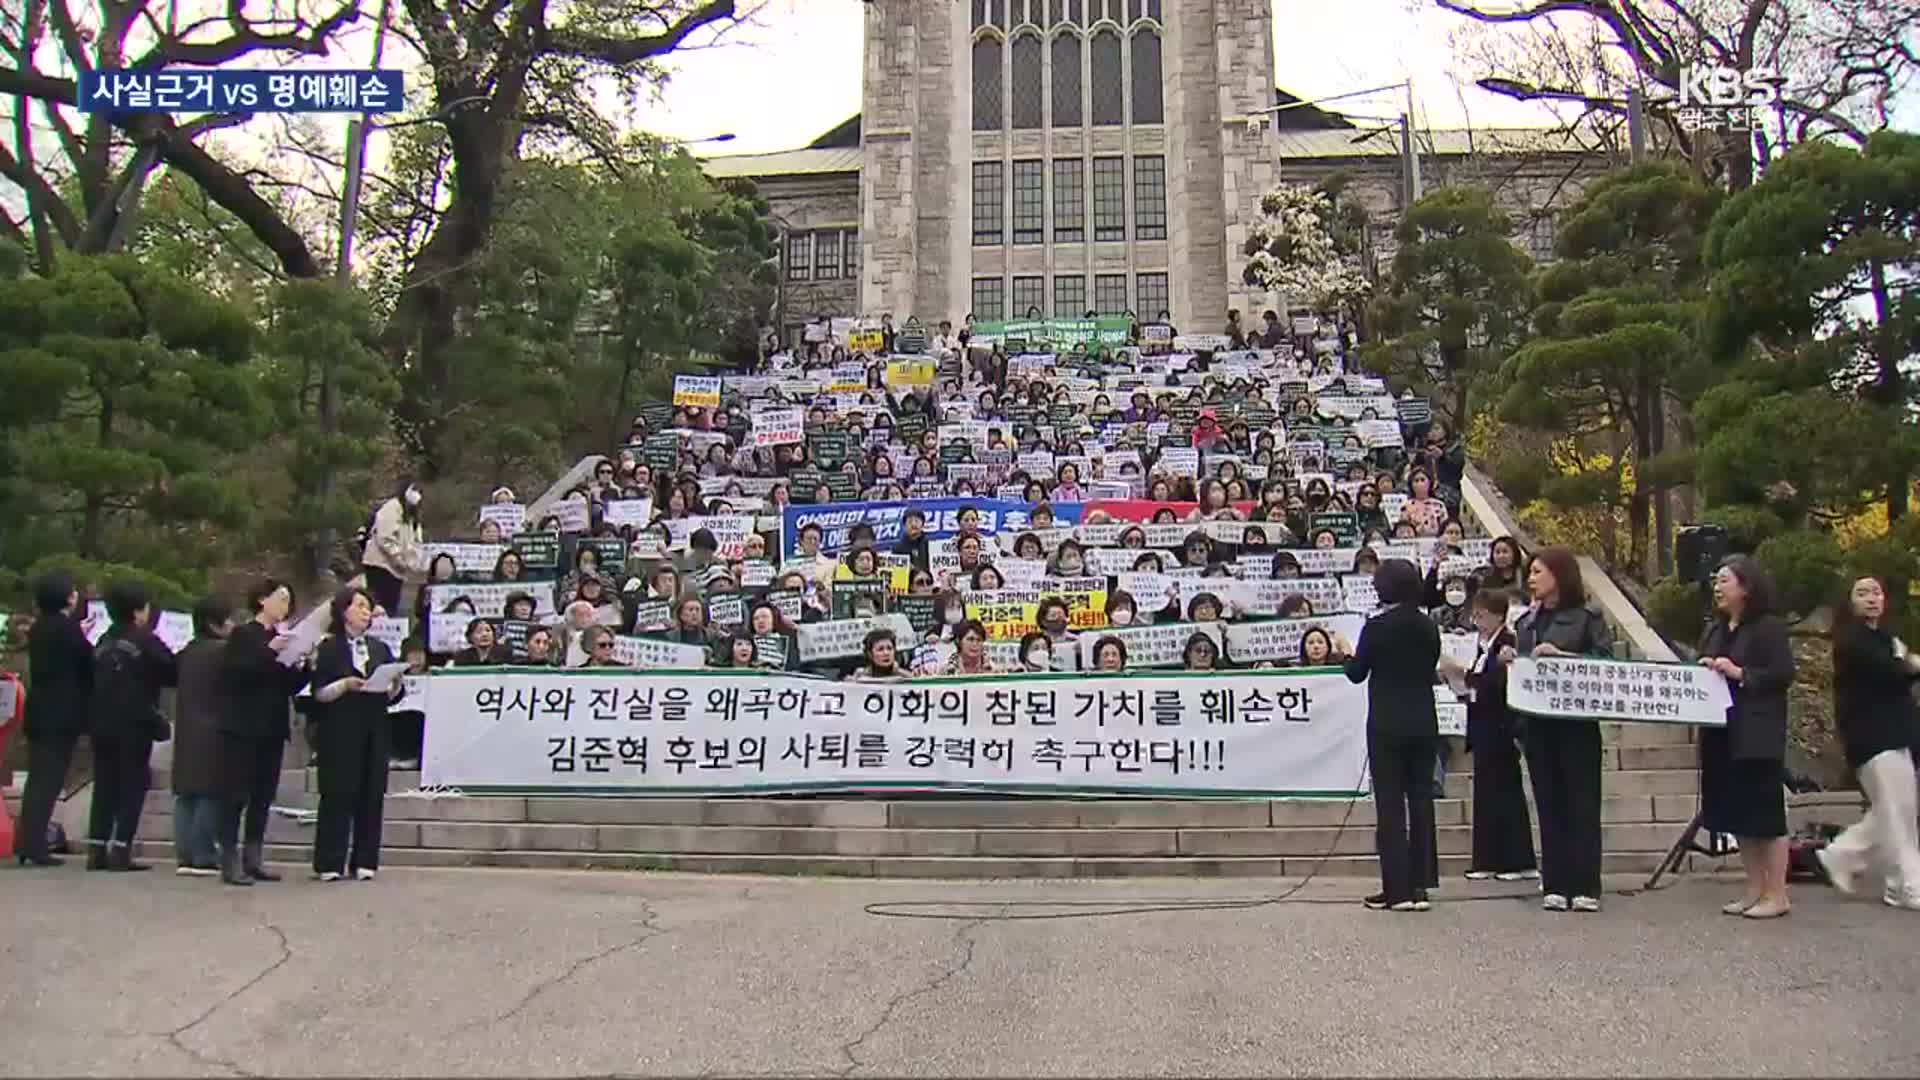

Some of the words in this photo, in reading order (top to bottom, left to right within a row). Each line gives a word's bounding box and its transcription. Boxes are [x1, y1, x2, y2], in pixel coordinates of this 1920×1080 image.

[978, 606, 1024, 623] 김준혁
[1535, 660, 1560, 676] 한국
[1617, 682, 1655, 699] 역사를
[475, 686, 576, 722] 역사와
[588, 686, 692, 722] 진실을
[704, 686, 848, 722] 왜곡하고
[863, 688, 968, 726] 이화의
[985, 690, 1057, 726] 참된
[1074, 689, 1186, 727] 가치를
[1199, 686, 1314, 724] 훼손한
[1549, 695, 1586, 711] 김준혁
[1589, 696, 1626, 713] 후보를
[547, 735, 649, 775] 김준혁
[663, 735, 767, 774] 후보의
[780, 732, 890, 769] 사퇴를
[903, 736, 1014, 771] 강력히
[1030, 738, 1226, 775] 촉구한다!!!
